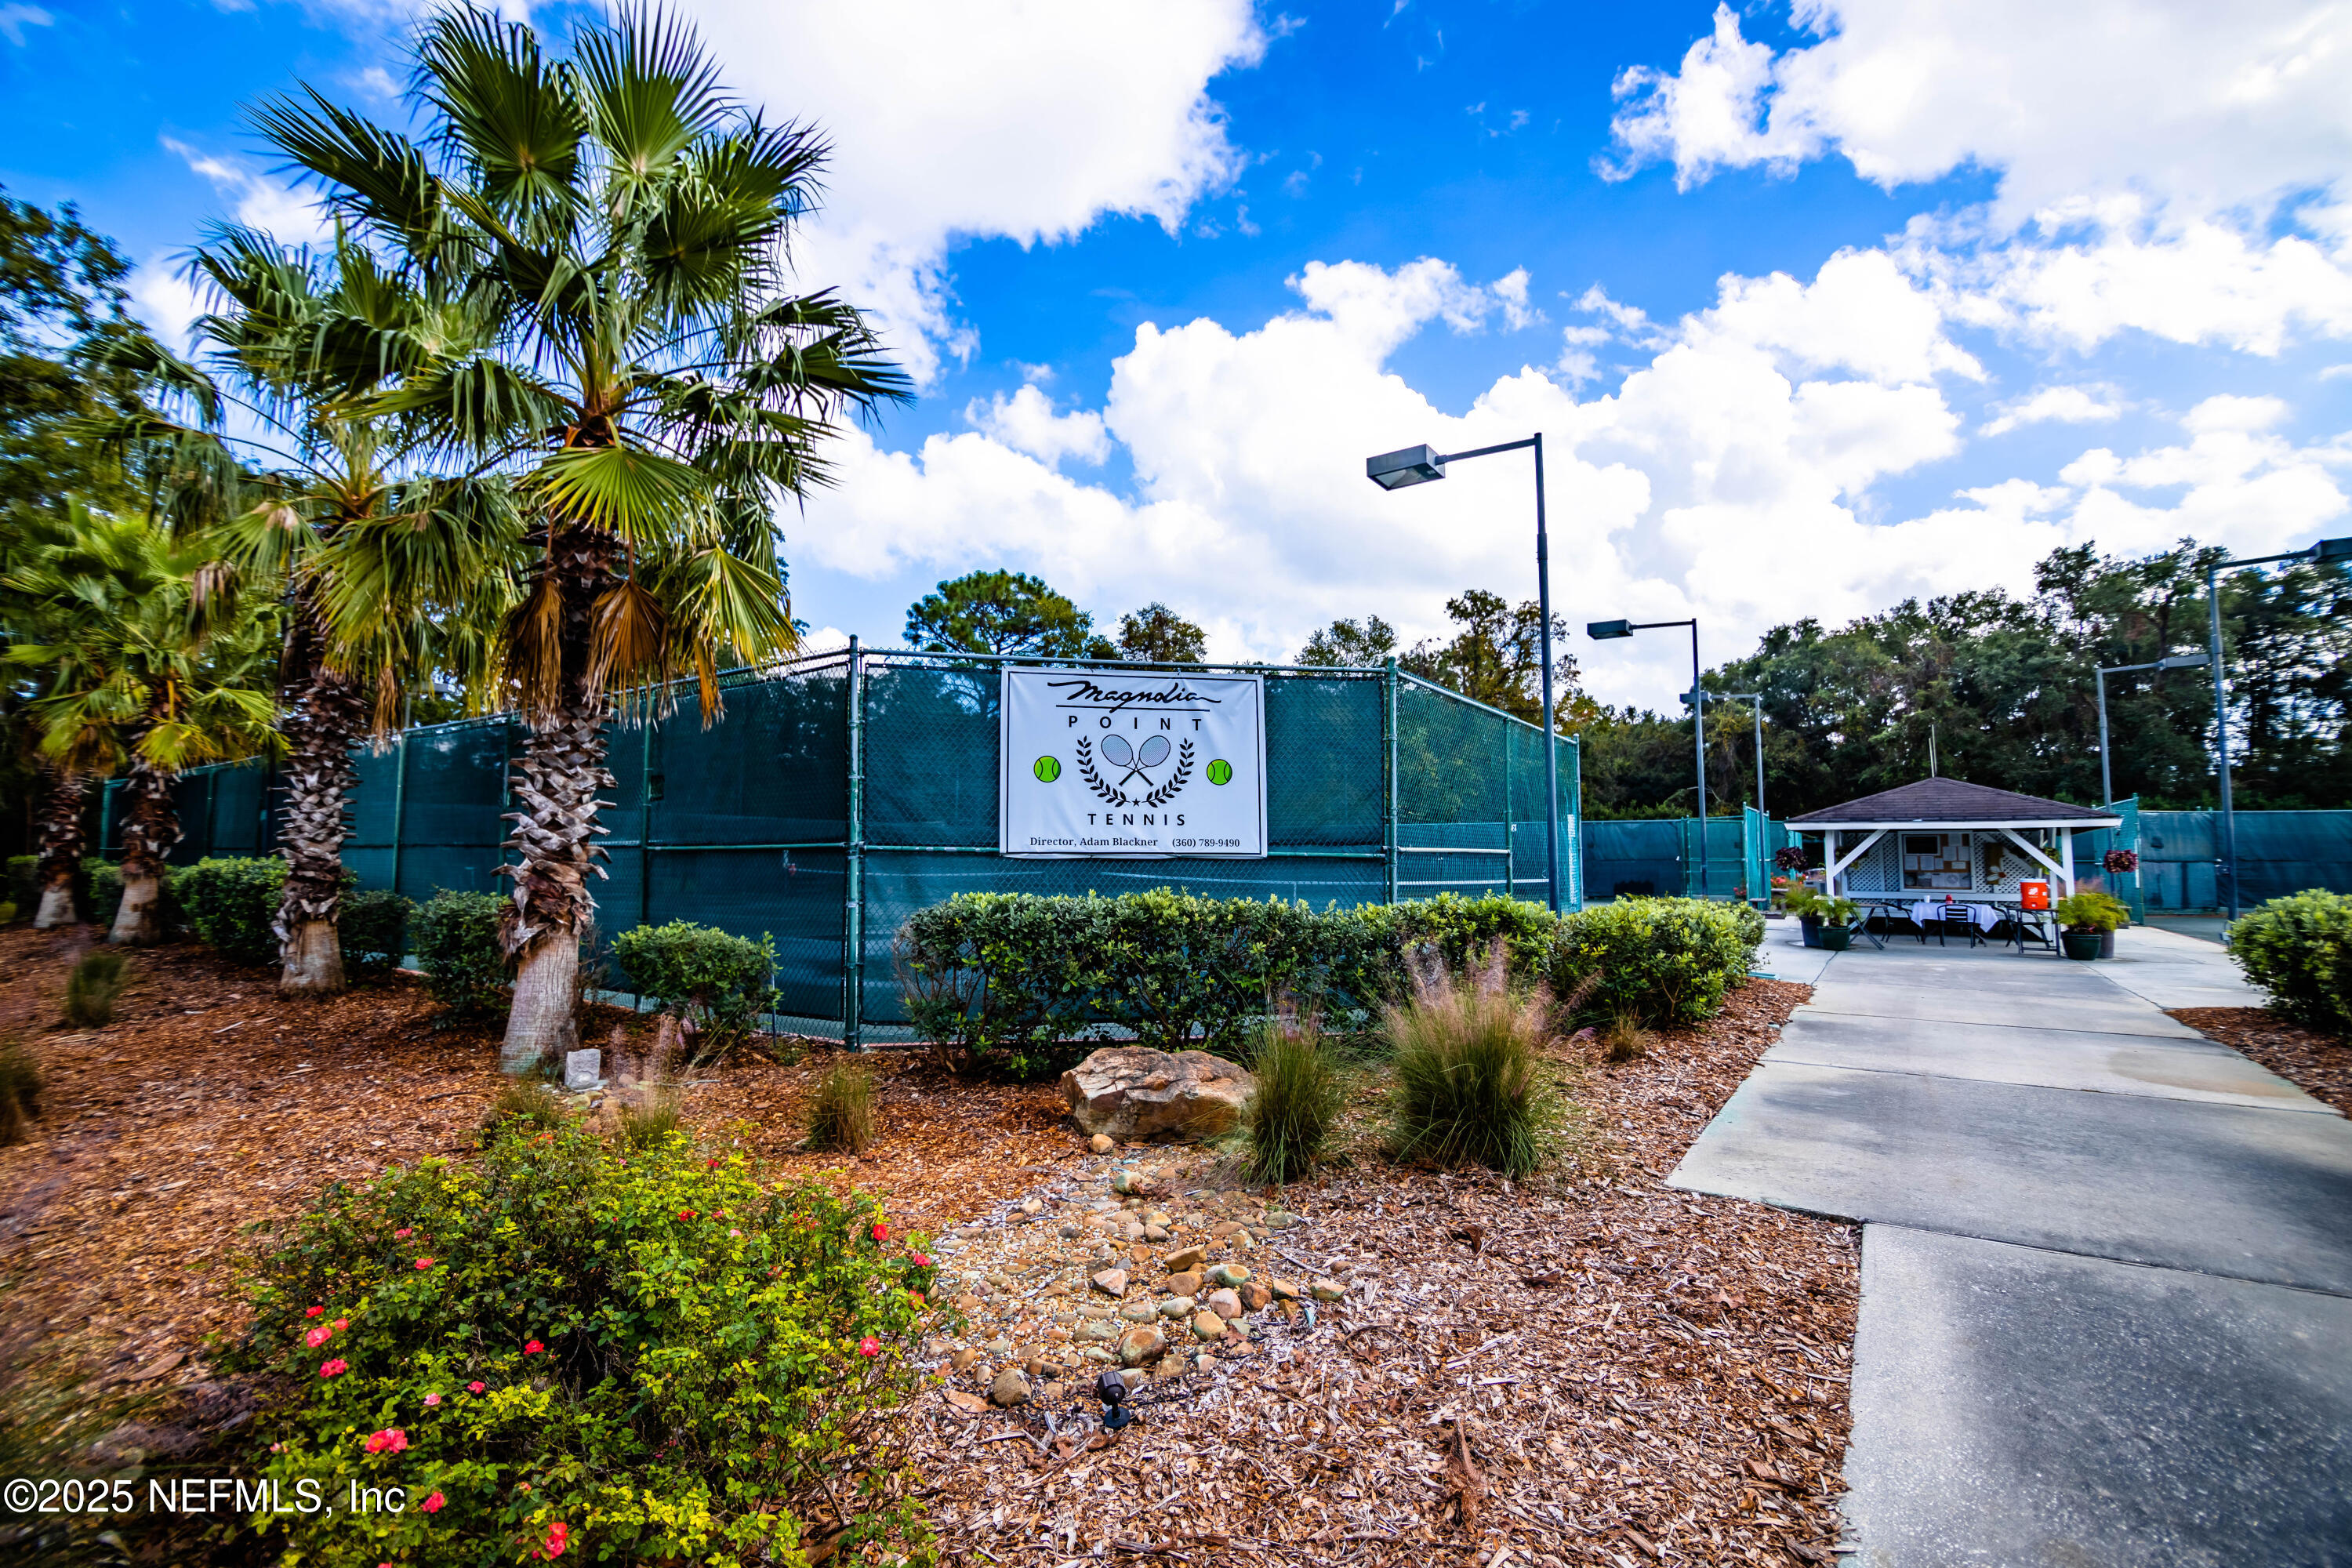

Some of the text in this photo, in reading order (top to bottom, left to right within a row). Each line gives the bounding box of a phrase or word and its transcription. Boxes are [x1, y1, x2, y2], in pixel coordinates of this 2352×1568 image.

[1047, 680, 1221, 713] Magnolia
[1069, 715, 1202, 731] POINT
[1087, 813, 1185, 826] TENNIS
[1030, 837, 1240, 848] Director, Adam Blackner (360) 789-9490
